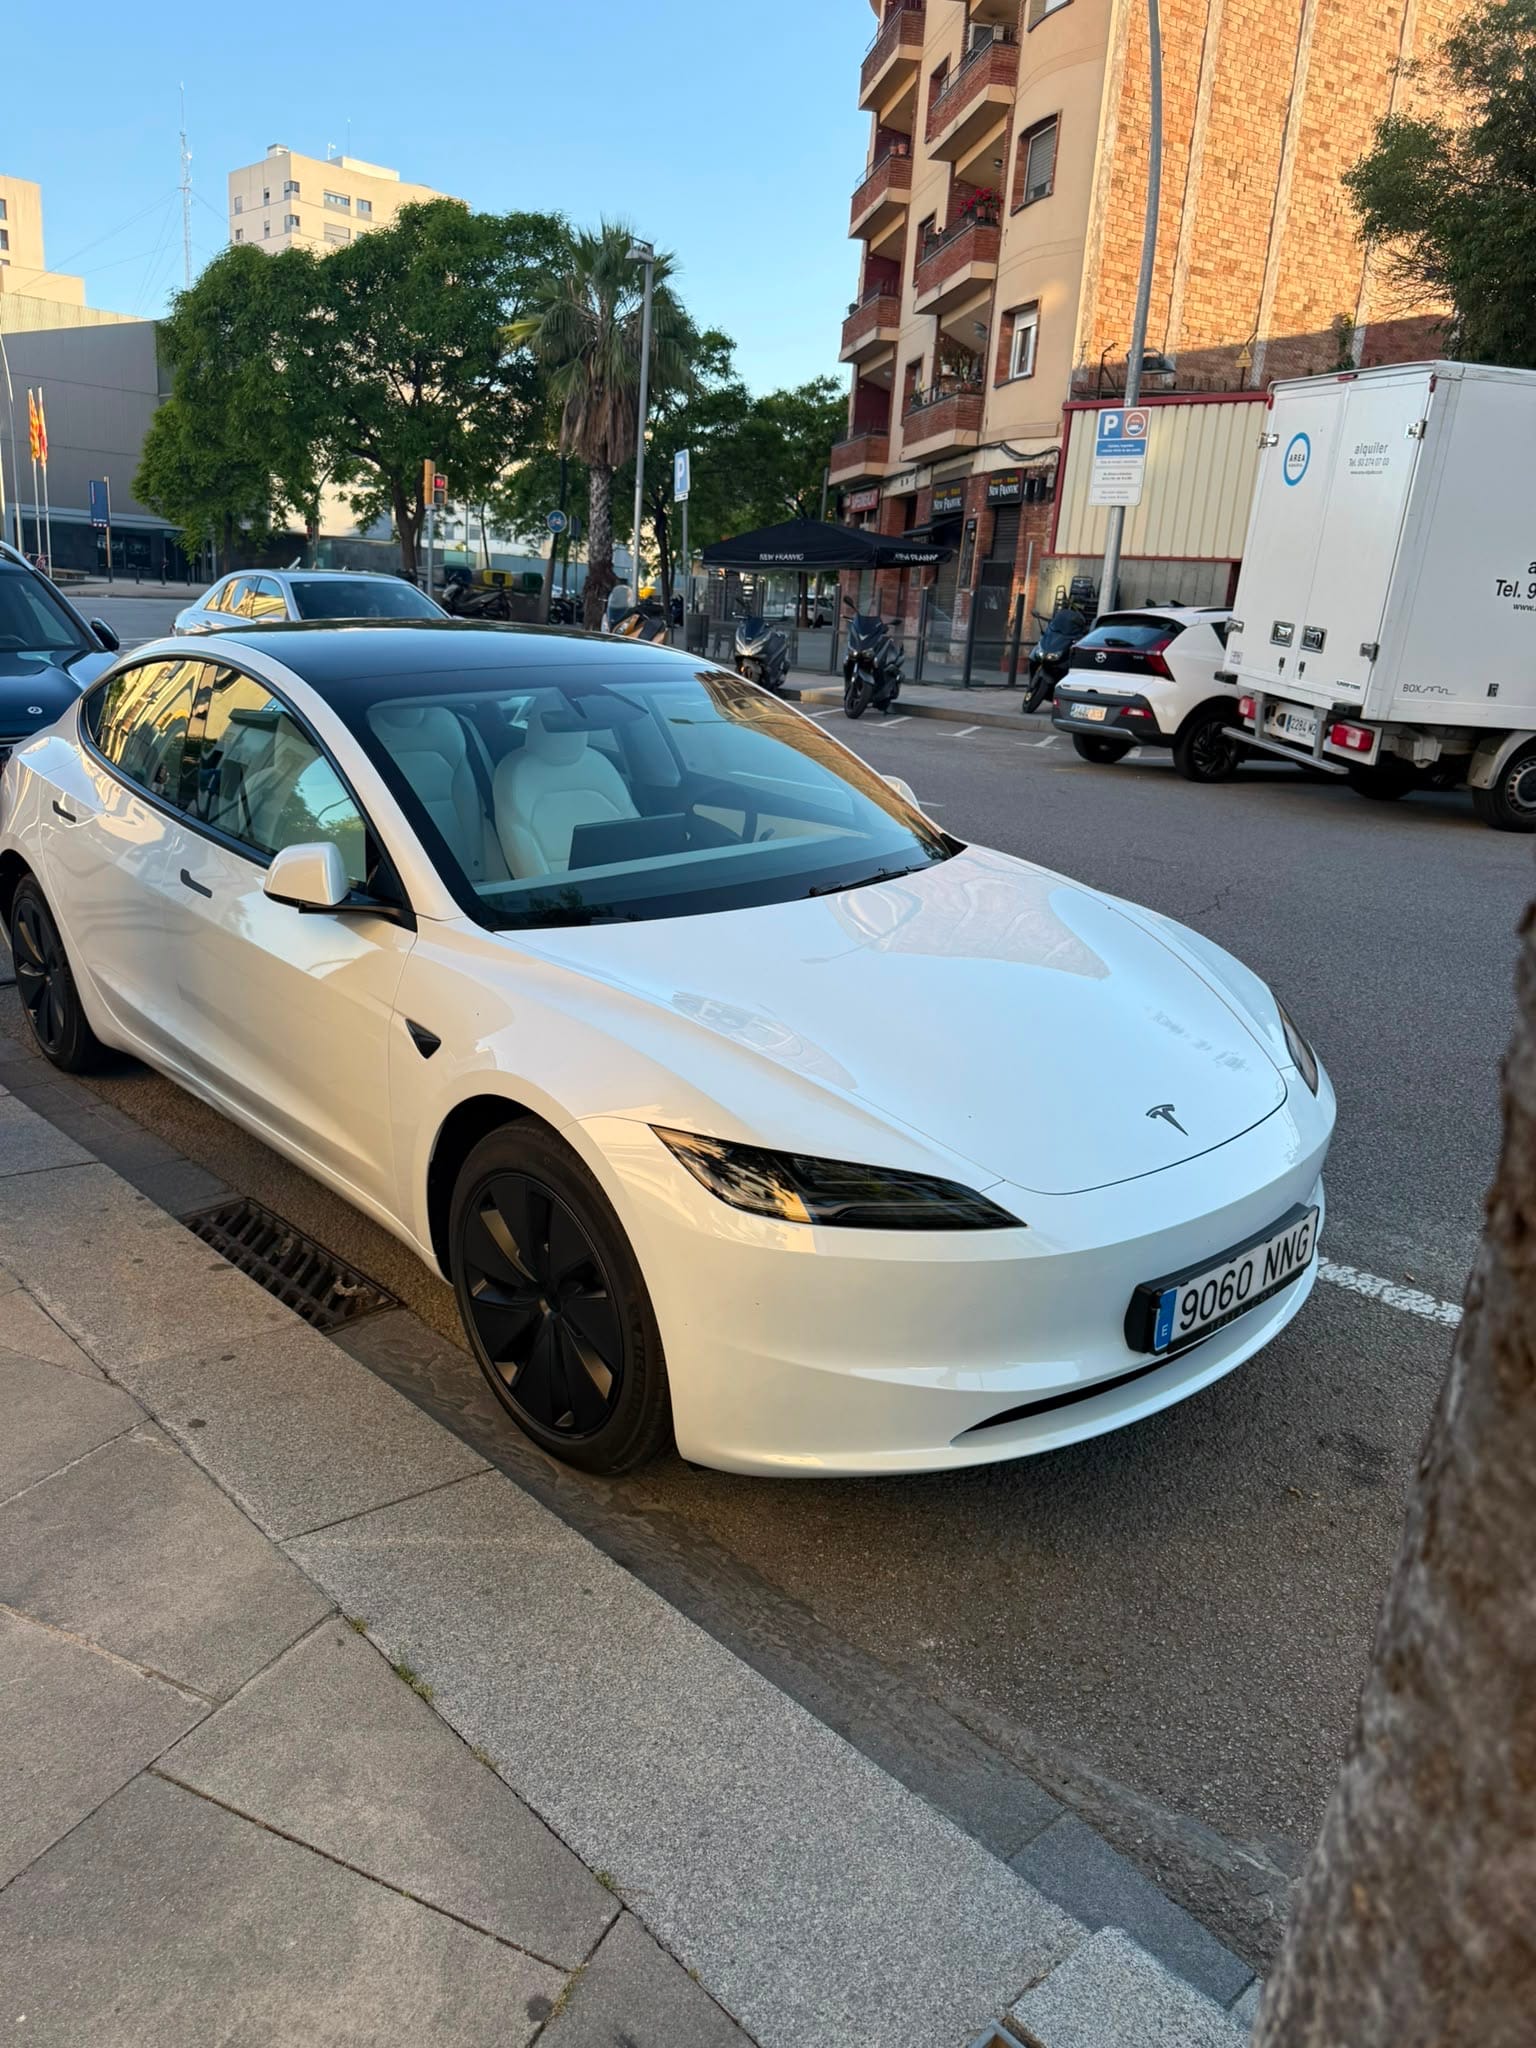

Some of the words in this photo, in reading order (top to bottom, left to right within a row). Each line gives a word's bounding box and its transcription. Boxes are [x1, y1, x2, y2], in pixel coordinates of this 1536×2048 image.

[1103, 414, 1118, 436] P
[1354, 442, 1389, 457] alquiler
[1289, 453, 1306, 462] AREA
[677, 456, 685, 489] P
[1496, 578, 1521, 598] Tel.
[1402, 683, 1421, 693] BOX
[1290, 717, 1307, 732] 2284
[1179, 1260, 1254, 1332] 9060
[1262, 1223, 1310, 1288] NNG
[1161, 1323, 1168, 1337] E
